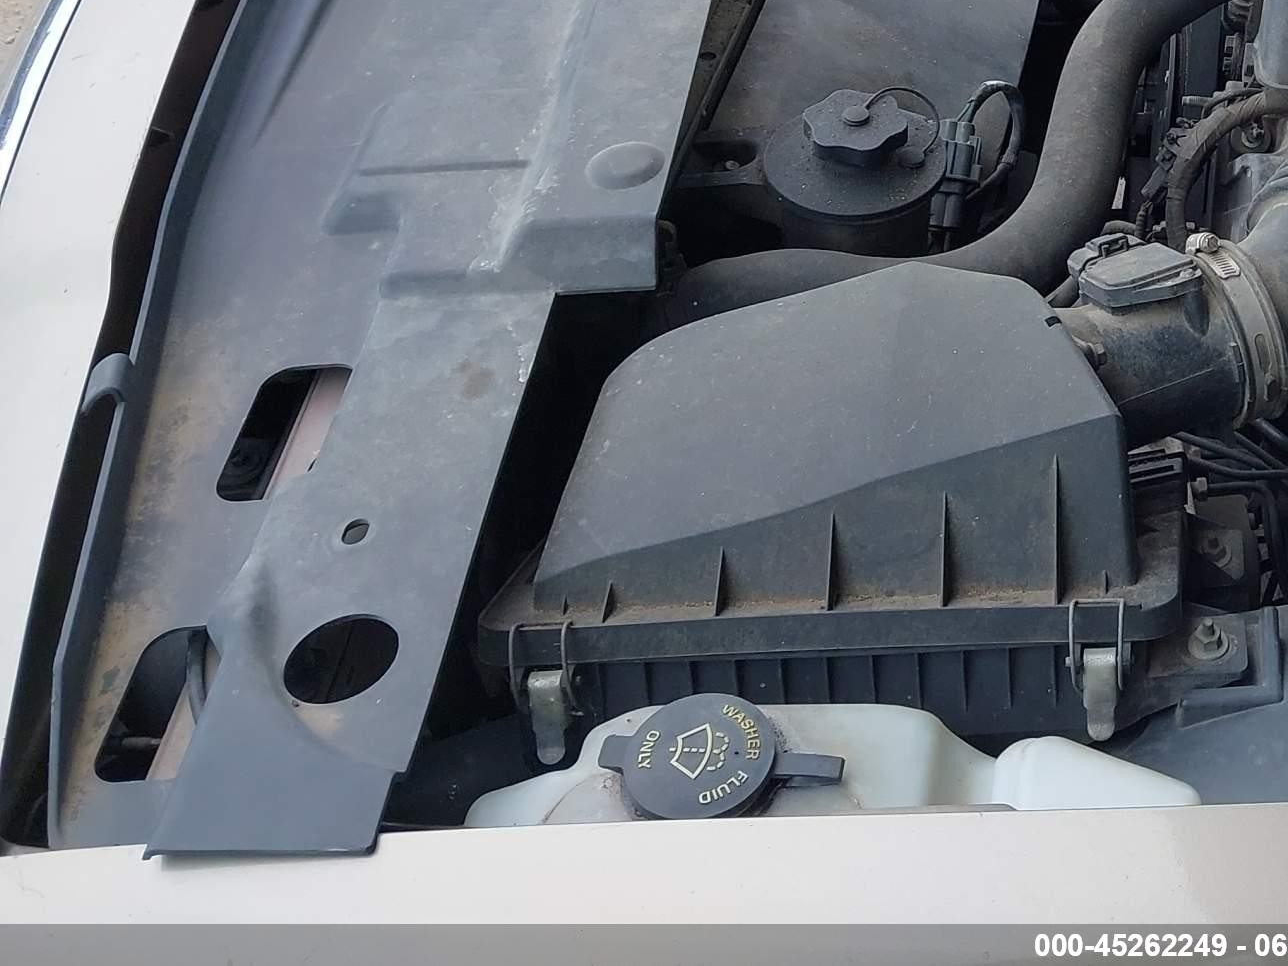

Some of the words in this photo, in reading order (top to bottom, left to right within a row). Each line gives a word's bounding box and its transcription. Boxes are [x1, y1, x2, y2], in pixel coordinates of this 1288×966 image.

[637, 729, 660, 770] ONLY
[721, 703, 761, 761] WASHER
[698, 770, 749, 804] FLUID
